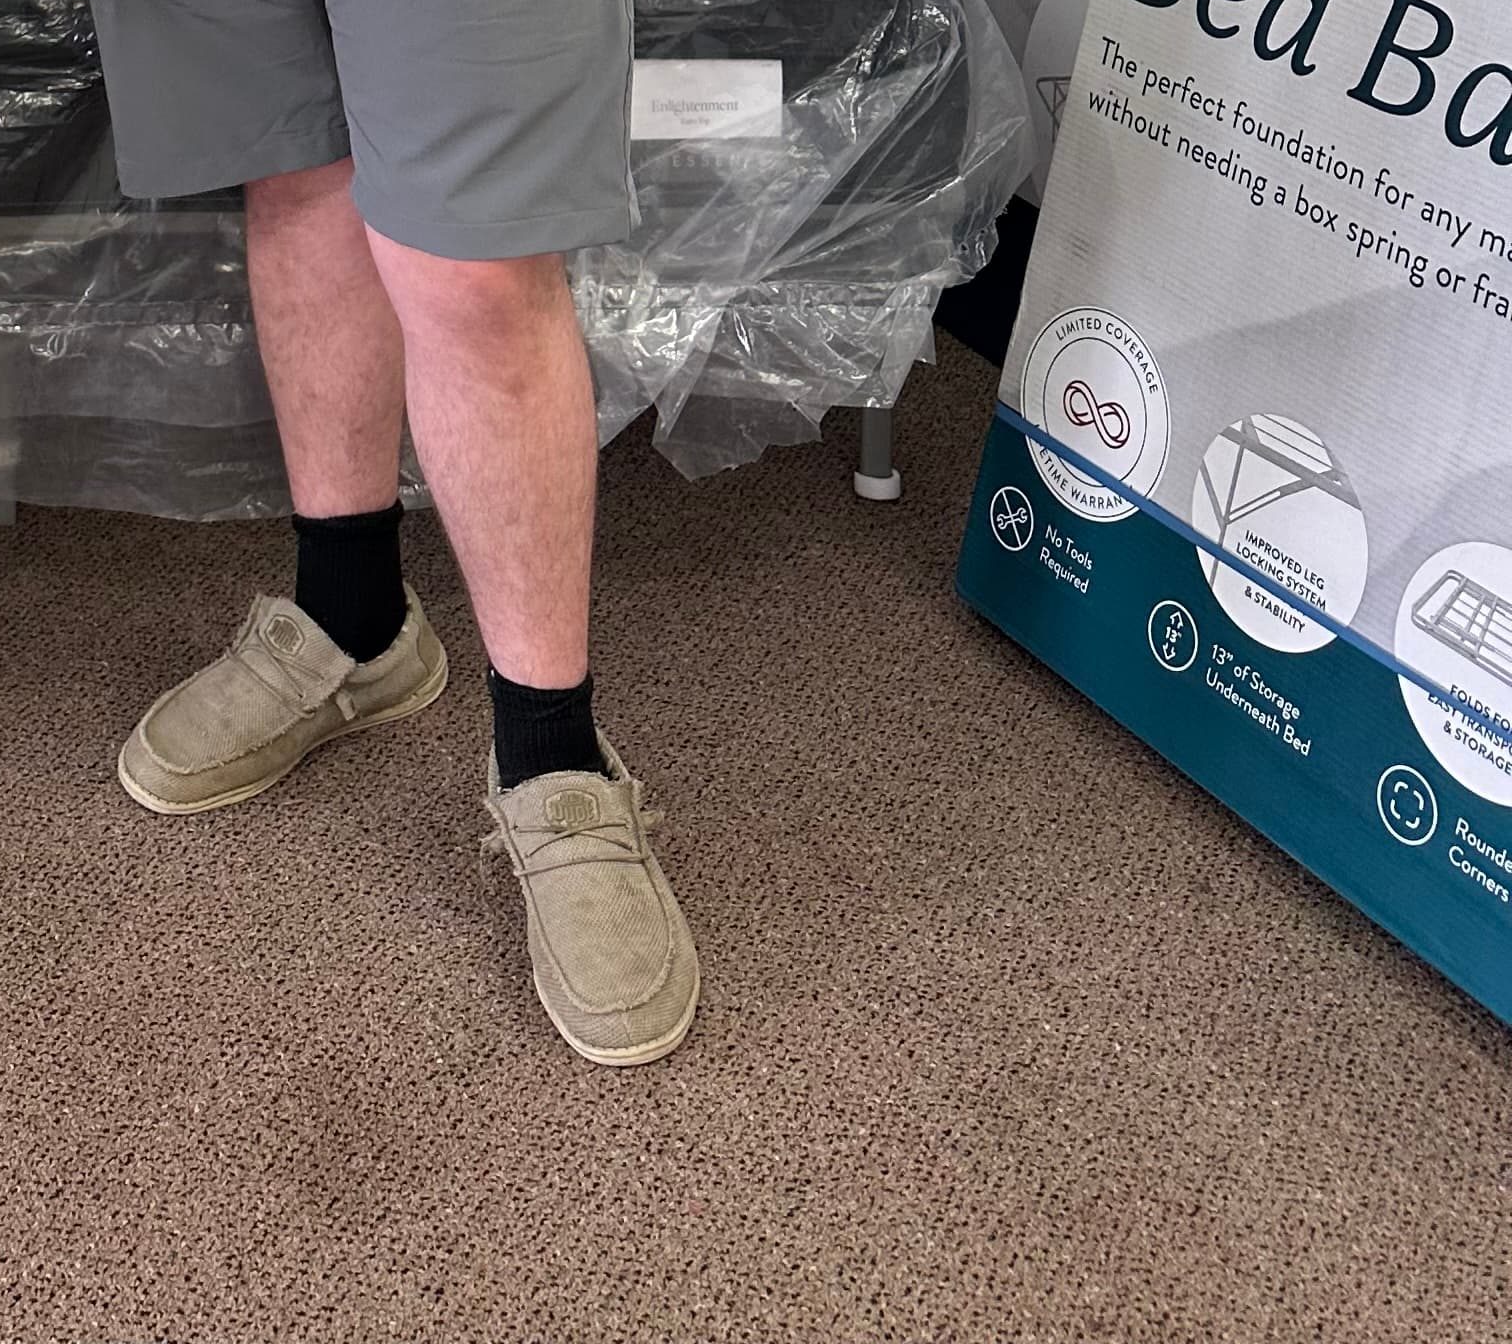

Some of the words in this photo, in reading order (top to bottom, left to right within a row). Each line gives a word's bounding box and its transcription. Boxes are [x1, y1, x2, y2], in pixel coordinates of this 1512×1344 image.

[652, 99, 738, 116] Enlightenment
[1102, 36, 1137, 78] The
[1142, 76, 1226, 122] perfect
[1233, 101, 1364, 189] foundation
[1374, 168, 1414, 210] for
[1421, 202, 1472, 248] any
[1089, 90, 1171, 147] without
[1177, 136, 1268, 206] needing
[1274, 185, 1287, 206] a
[1294, 184, 1338, 232] box
[1346, 222, 1428, 288] spring
[1436, 267, 1466, 293] or
[1473, 273, 1512, 321] fra
[1055, 317, 1102, 341] LIMITED
[1105, 322, 1158, 394] COVERAGE
[1071, 485, 1126, 510] WARRAN
[1040, 546, 1089, 593] Required
[1045, 524, 1062, 548] No
[1066, 537, 1092, 570] Tools
[1245, 530, 1302, 574] IMPROVED
[1304, 568, 1325, 590] LEG
[1236, 543, 1284, 582] LOCKING
[1286, 576, 1326, 612] SYSTEM
[1244, 586, 1252, 599] &
[1254, 592, 1305, 632] STABILITY
[1206, 667, 1280, 735] Underneath
[1283, 725, 1311, 757] Bed
[1234, 665, 1251, 681] of
[1250, 671, 1300, 720] Storage
[1450, 684, 1491, 718] FOLDS
[1493, 712, 1512, 734] FO
[1443, 720, 1451, 734] &
[1454, 728, 1512, 776] STORAGE
[1449, 846, 1510, 903] Corners
